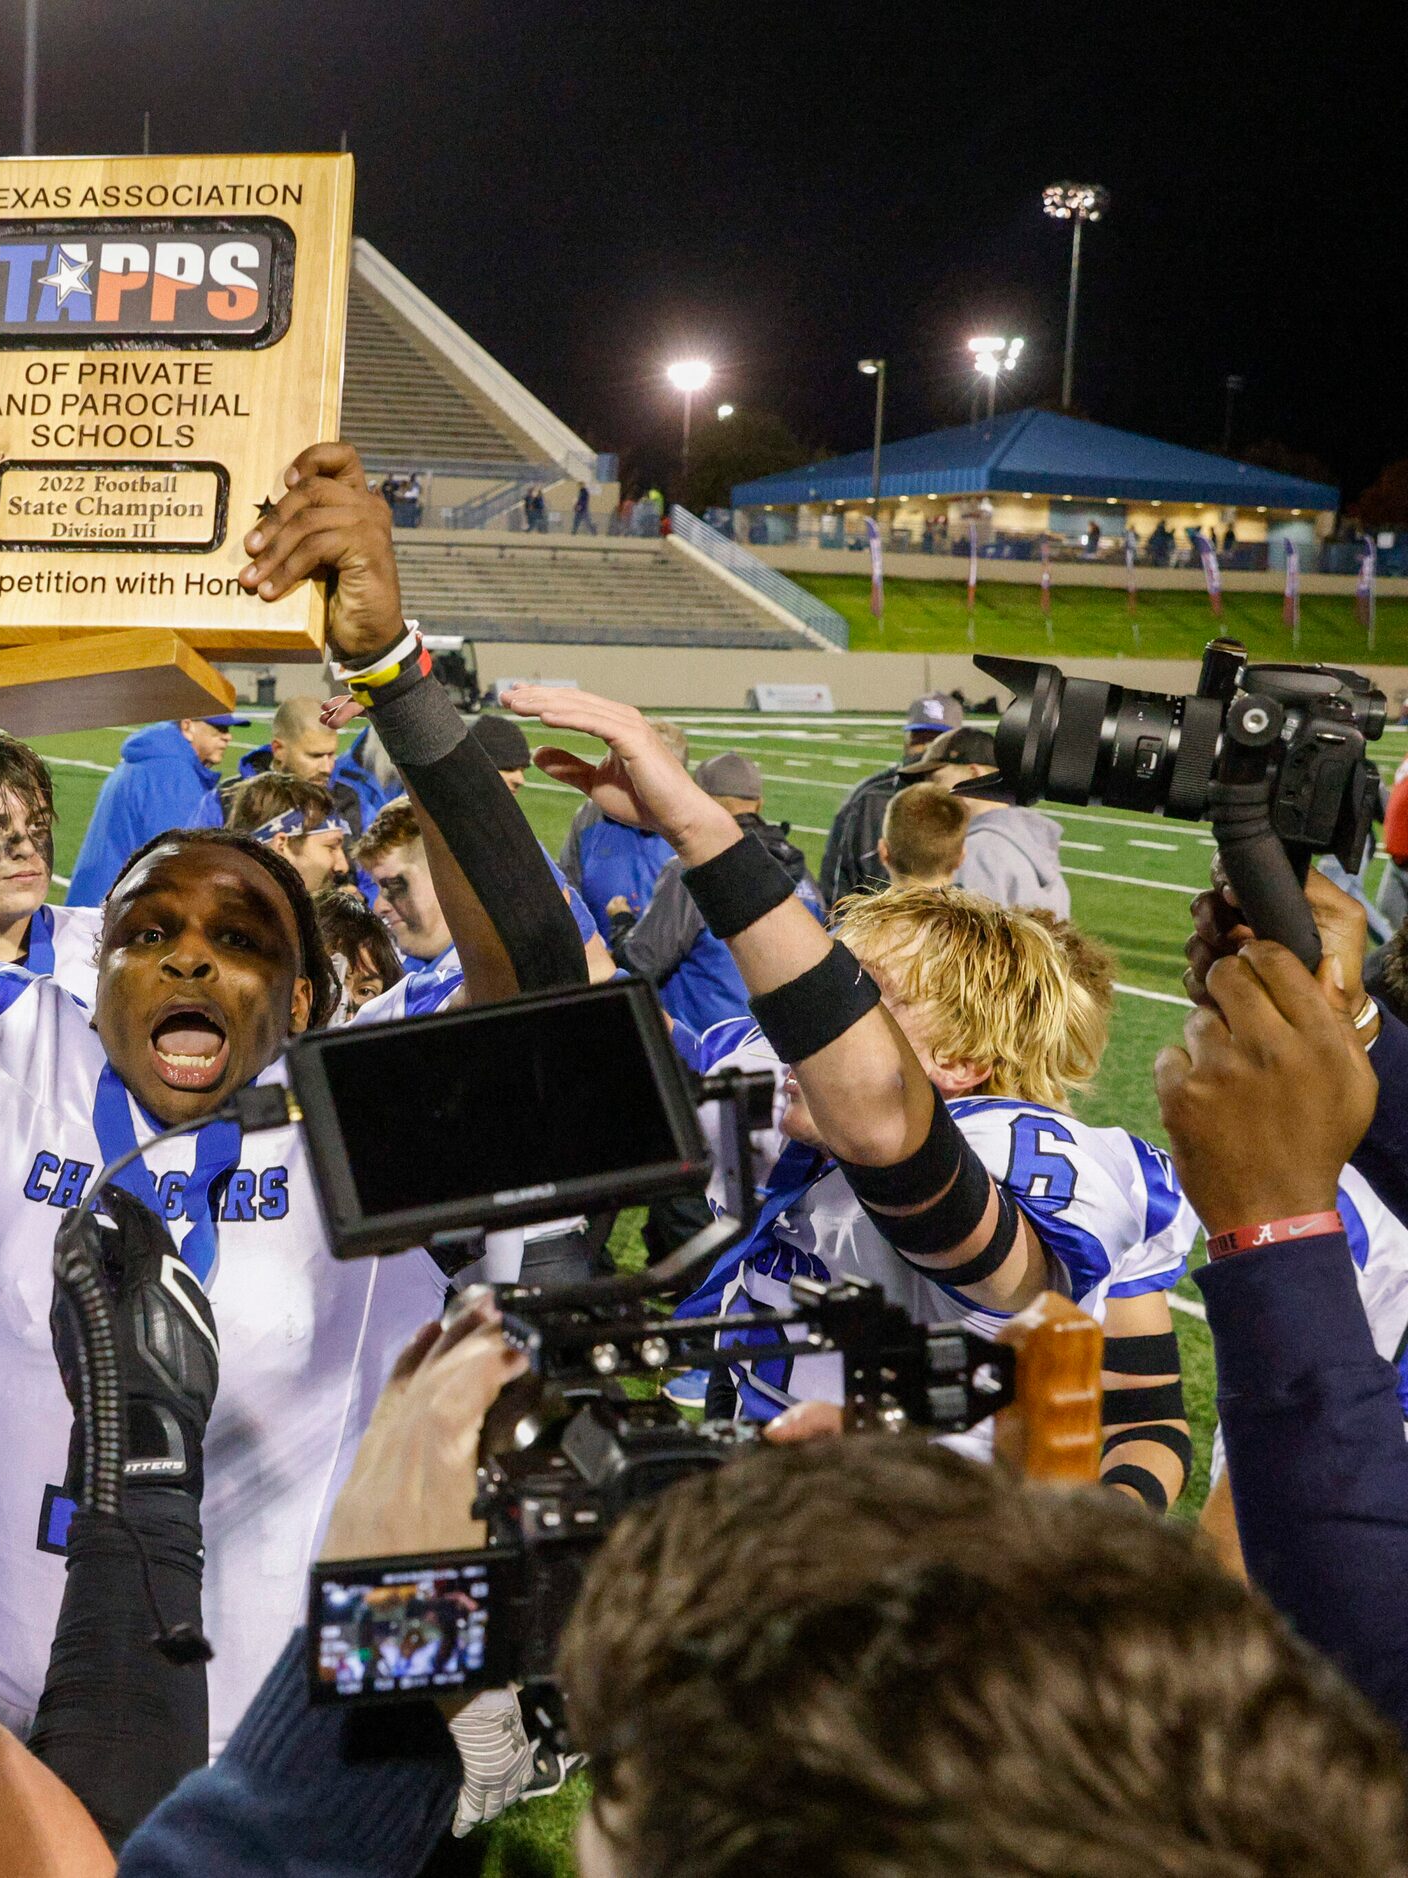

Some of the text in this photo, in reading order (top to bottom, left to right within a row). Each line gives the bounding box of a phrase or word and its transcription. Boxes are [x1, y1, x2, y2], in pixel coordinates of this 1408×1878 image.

[79, 184, 304, 208] ASSOCIATION
[24, 362, 213, 386] OF PRIVATE
[61, 394, 251, 417] PAROCHIAL
[31, 424, 195, 448] SCHOOLS
[38, 475, 177, 494] 2022 Football
[7, 496, 204, 522] State Champion
[50, 522, 156, 539] Division III
[116, 571, 174, 596] with
[185, 573, 258, 596] Hon
[1001, 1112, 1079, 1216] 6
[23, 1149, 290, 1223] CHGRS
[123, 1460, 184, 1474] TTERS
